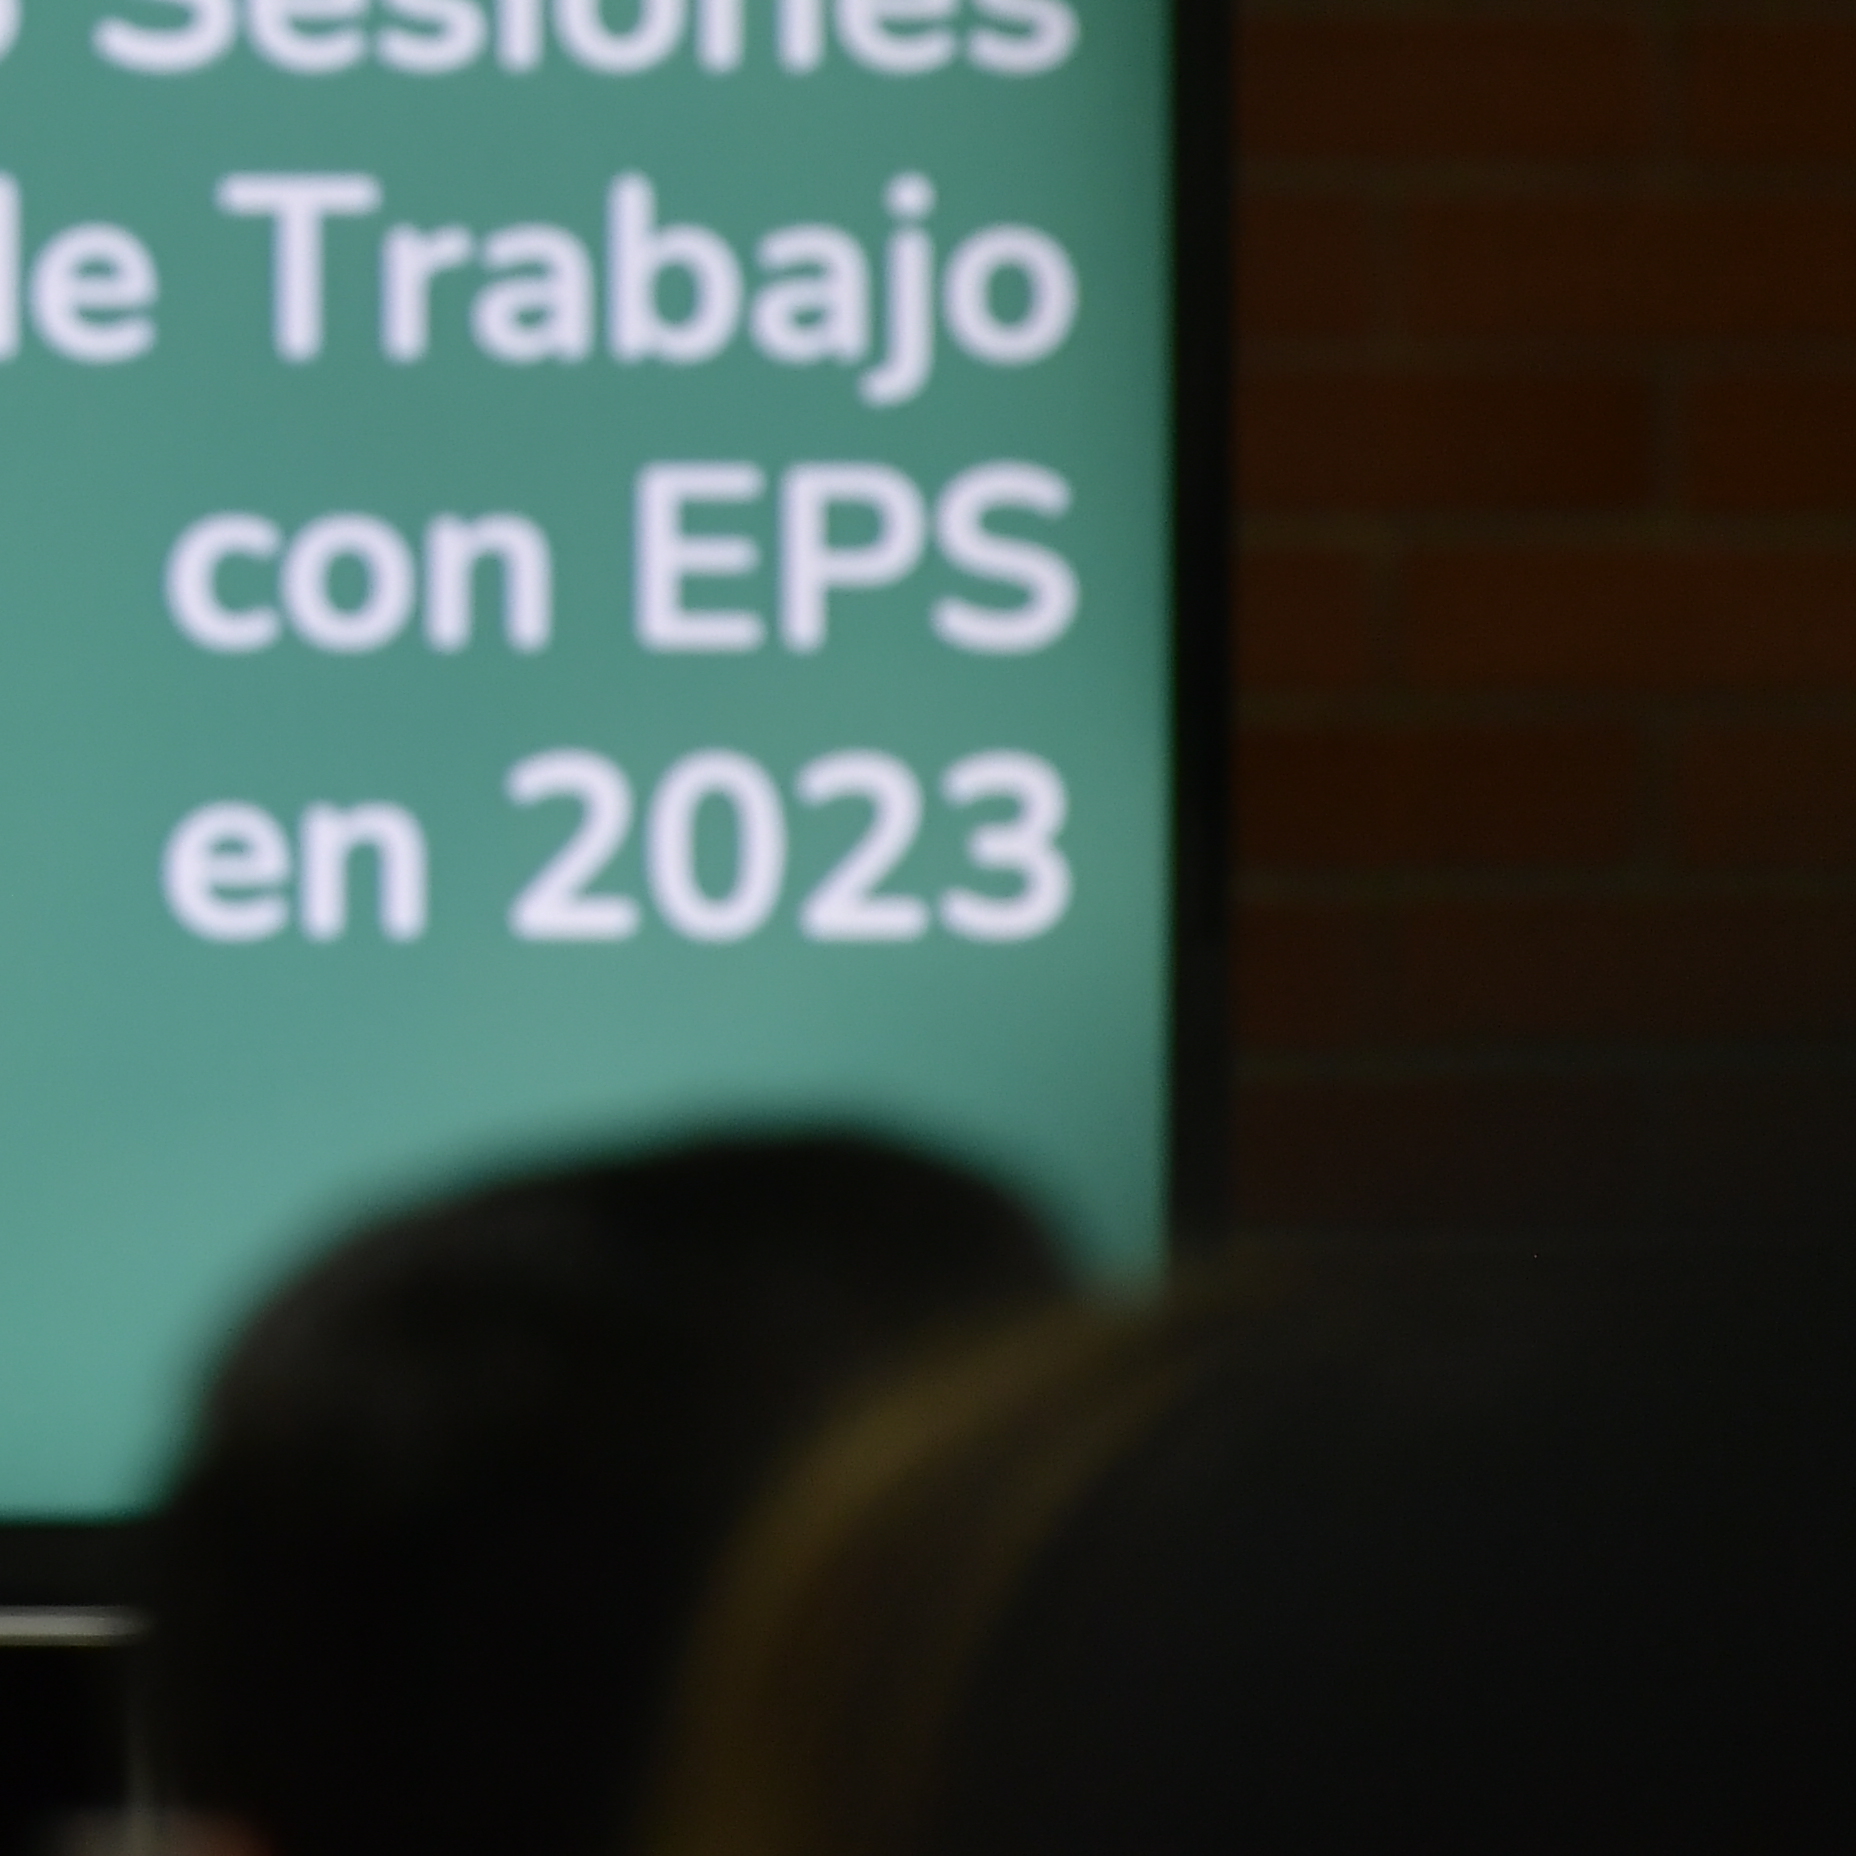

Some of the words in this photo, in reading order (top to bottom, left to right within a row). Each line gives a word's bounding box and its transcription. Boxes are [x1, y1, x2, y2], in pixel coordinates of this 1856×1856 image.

[215, 171, 1078, 406] Trabajo
[164, 511, 552, 654] con
[633, 460, 1078, 654] EPS
[161, 799, 428, 944] en
[506, 746, 1073, 944] 2023
